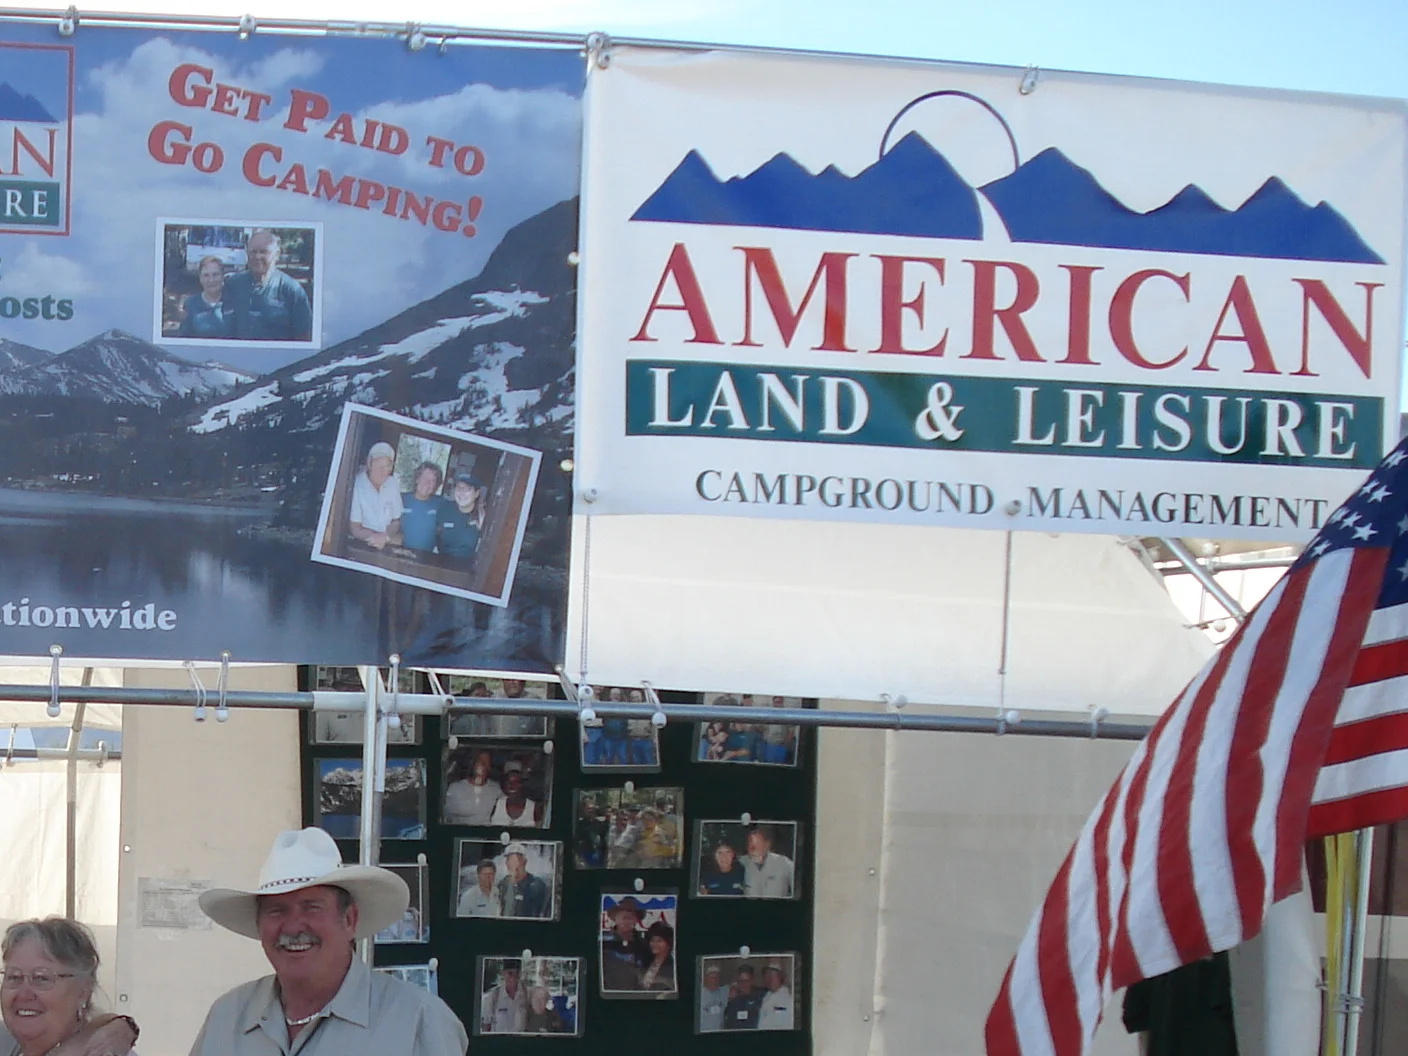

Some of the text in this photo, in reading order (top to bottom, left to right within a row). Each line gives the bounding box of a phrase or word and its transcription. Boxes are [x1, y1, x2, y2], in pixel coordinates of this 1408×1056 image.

[168, 63, 271, 122] GET
[283, 88, 410, 156] PAID
[147, 121, 483, 238] GO CAMPING!
[629, 242, 1385, 380] AMERICAN
[647, 367, 1356, 460] LAND & LEISURE
[695, 469, 1329, 529] CAMPGROUND MANAGEMENT
